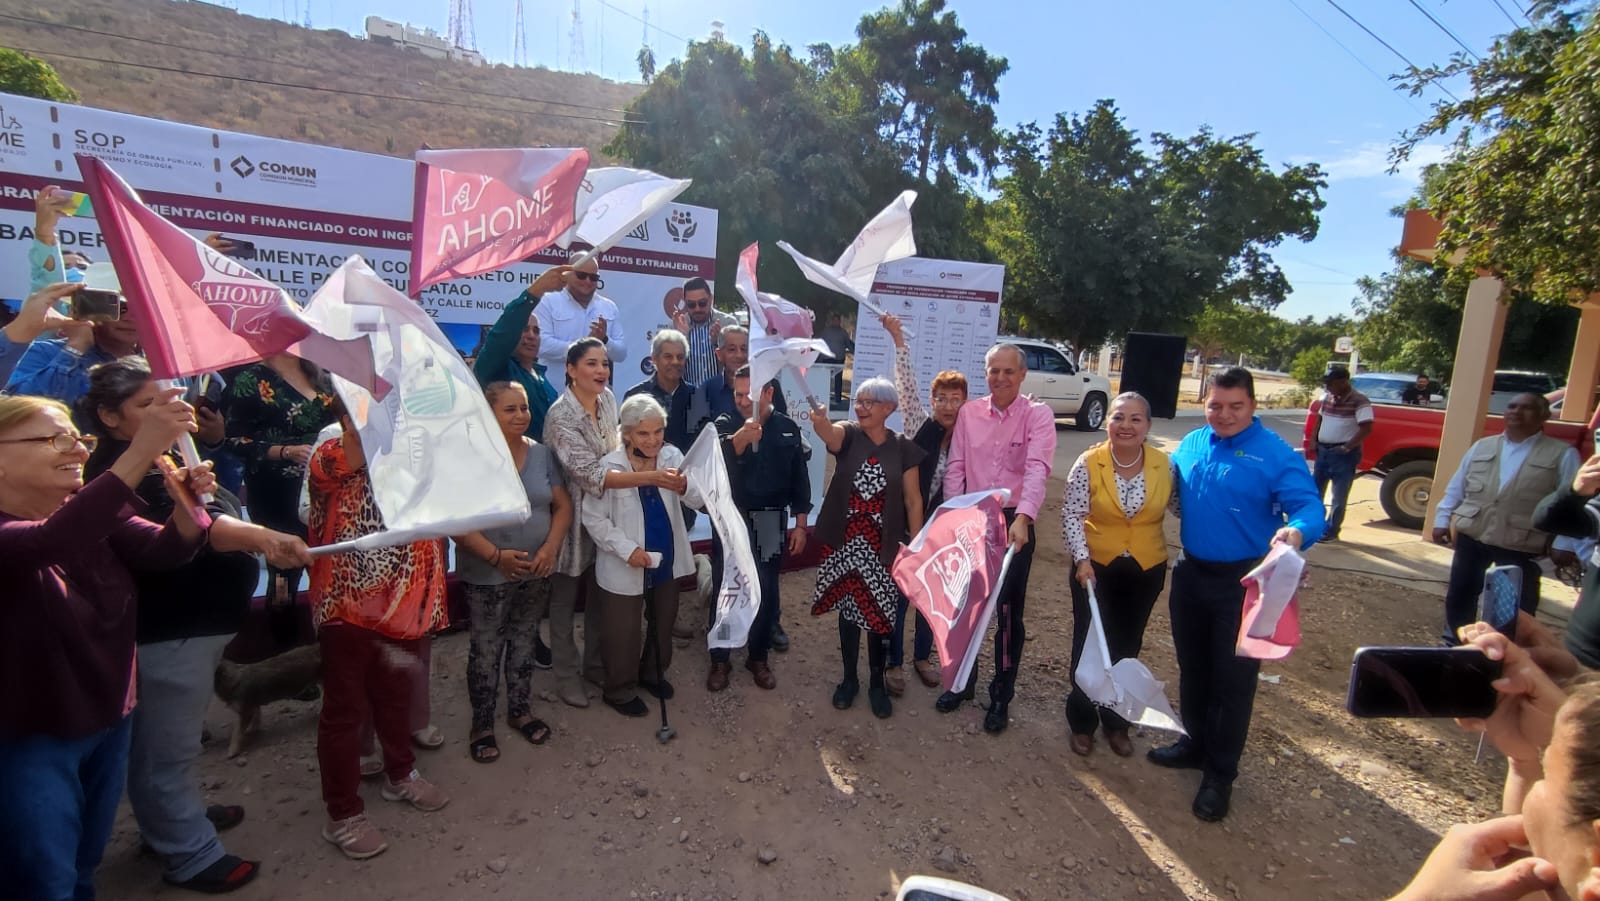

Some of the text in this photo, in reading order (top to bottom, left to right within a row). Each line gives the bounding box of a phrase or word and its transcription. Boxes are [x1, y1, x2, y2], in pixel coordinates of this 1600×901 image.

[75, 129, 125, 148] SOP
[259, 161, 317, 179] COMUN
[437, 178, 558, 257] AHOME
[250, 215, 344, 234] FINANCIADO
[348, 226, 378, 238] CON
[601, 254, 633, 265] AUTOS
[635, 258, 699, 272] EXTRANJEROS
[427, 297, 435, 306] Y
[437, 299, 473, 309] CALLE
